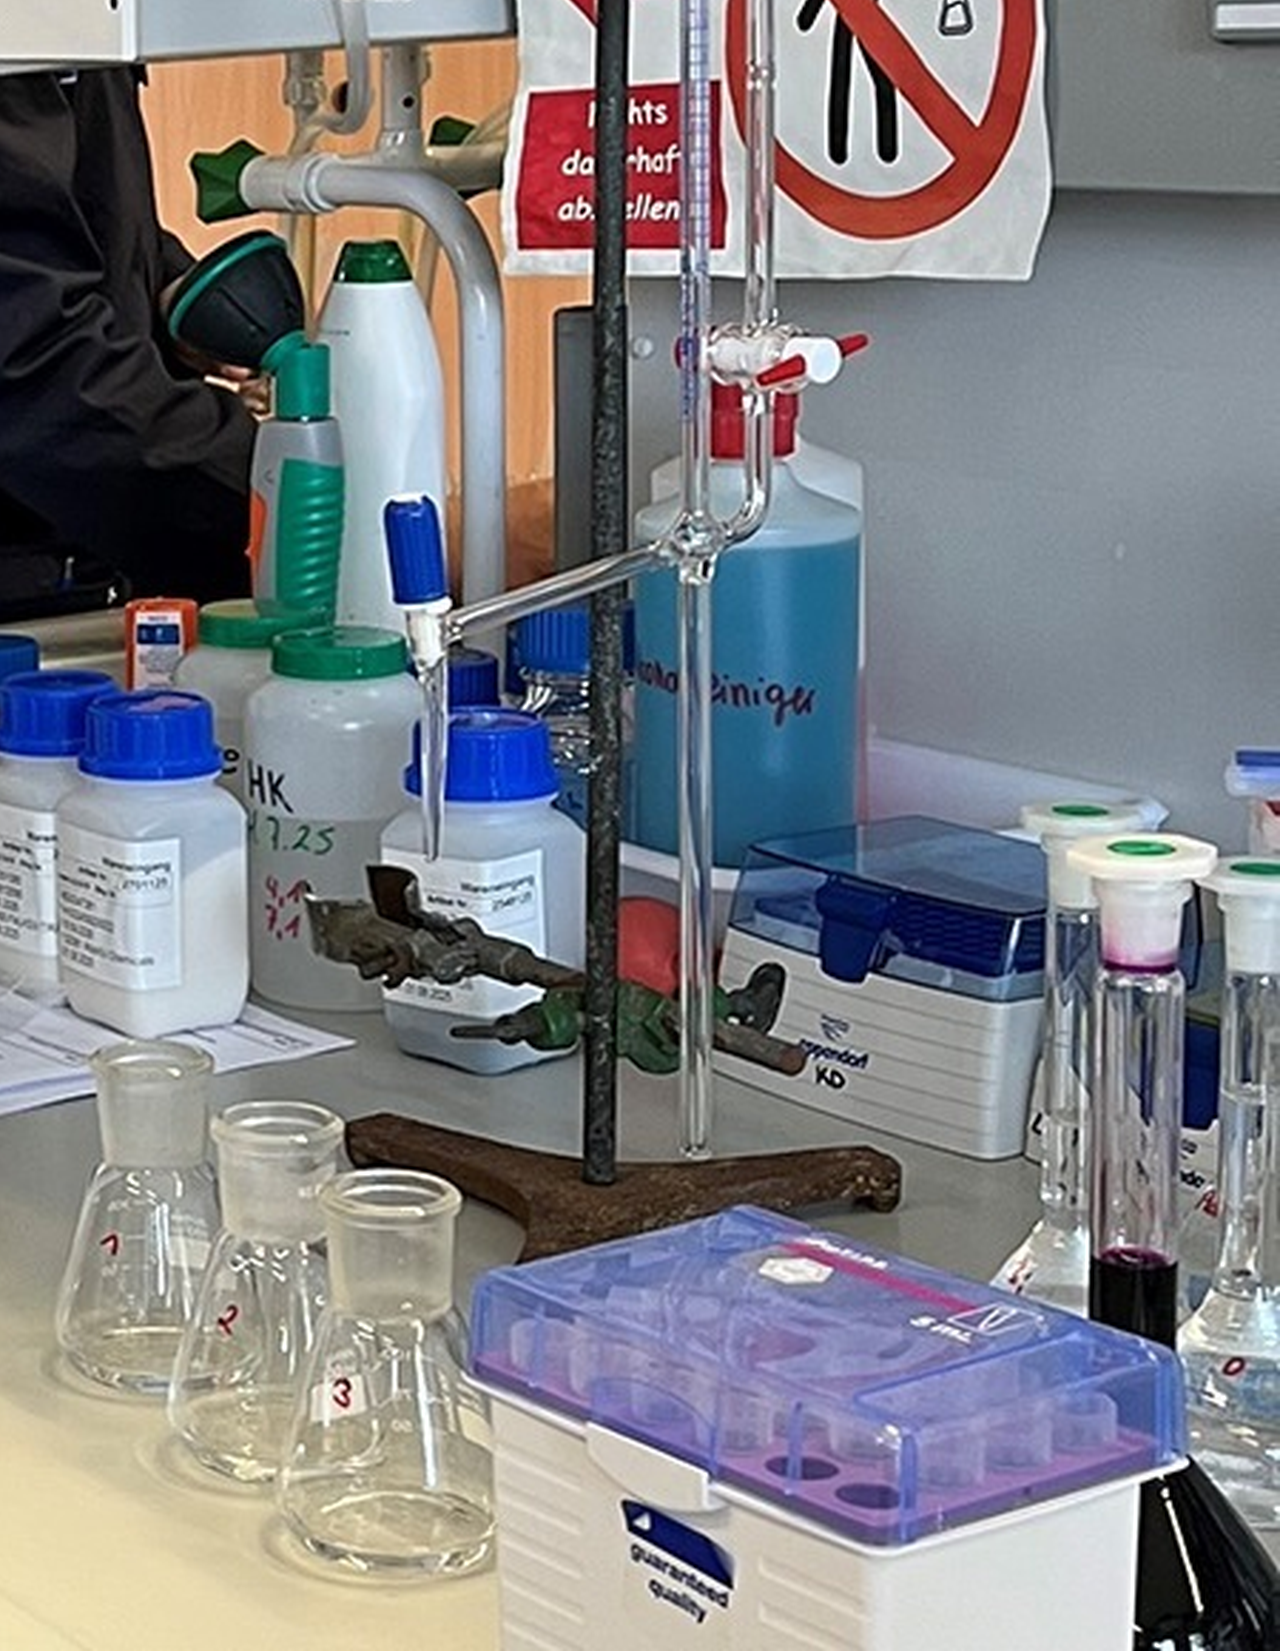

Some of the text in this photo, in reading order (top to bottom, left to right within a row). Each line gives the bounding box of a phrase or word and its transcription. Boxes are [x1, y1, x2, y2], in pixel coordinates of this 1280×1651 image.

[588, 98, 669, 129] hts
[332, 1377, 352, 1409] 3
[630, 1542, 729, 1609] guaranteed
[648, 1578, 707, 1624] quality
